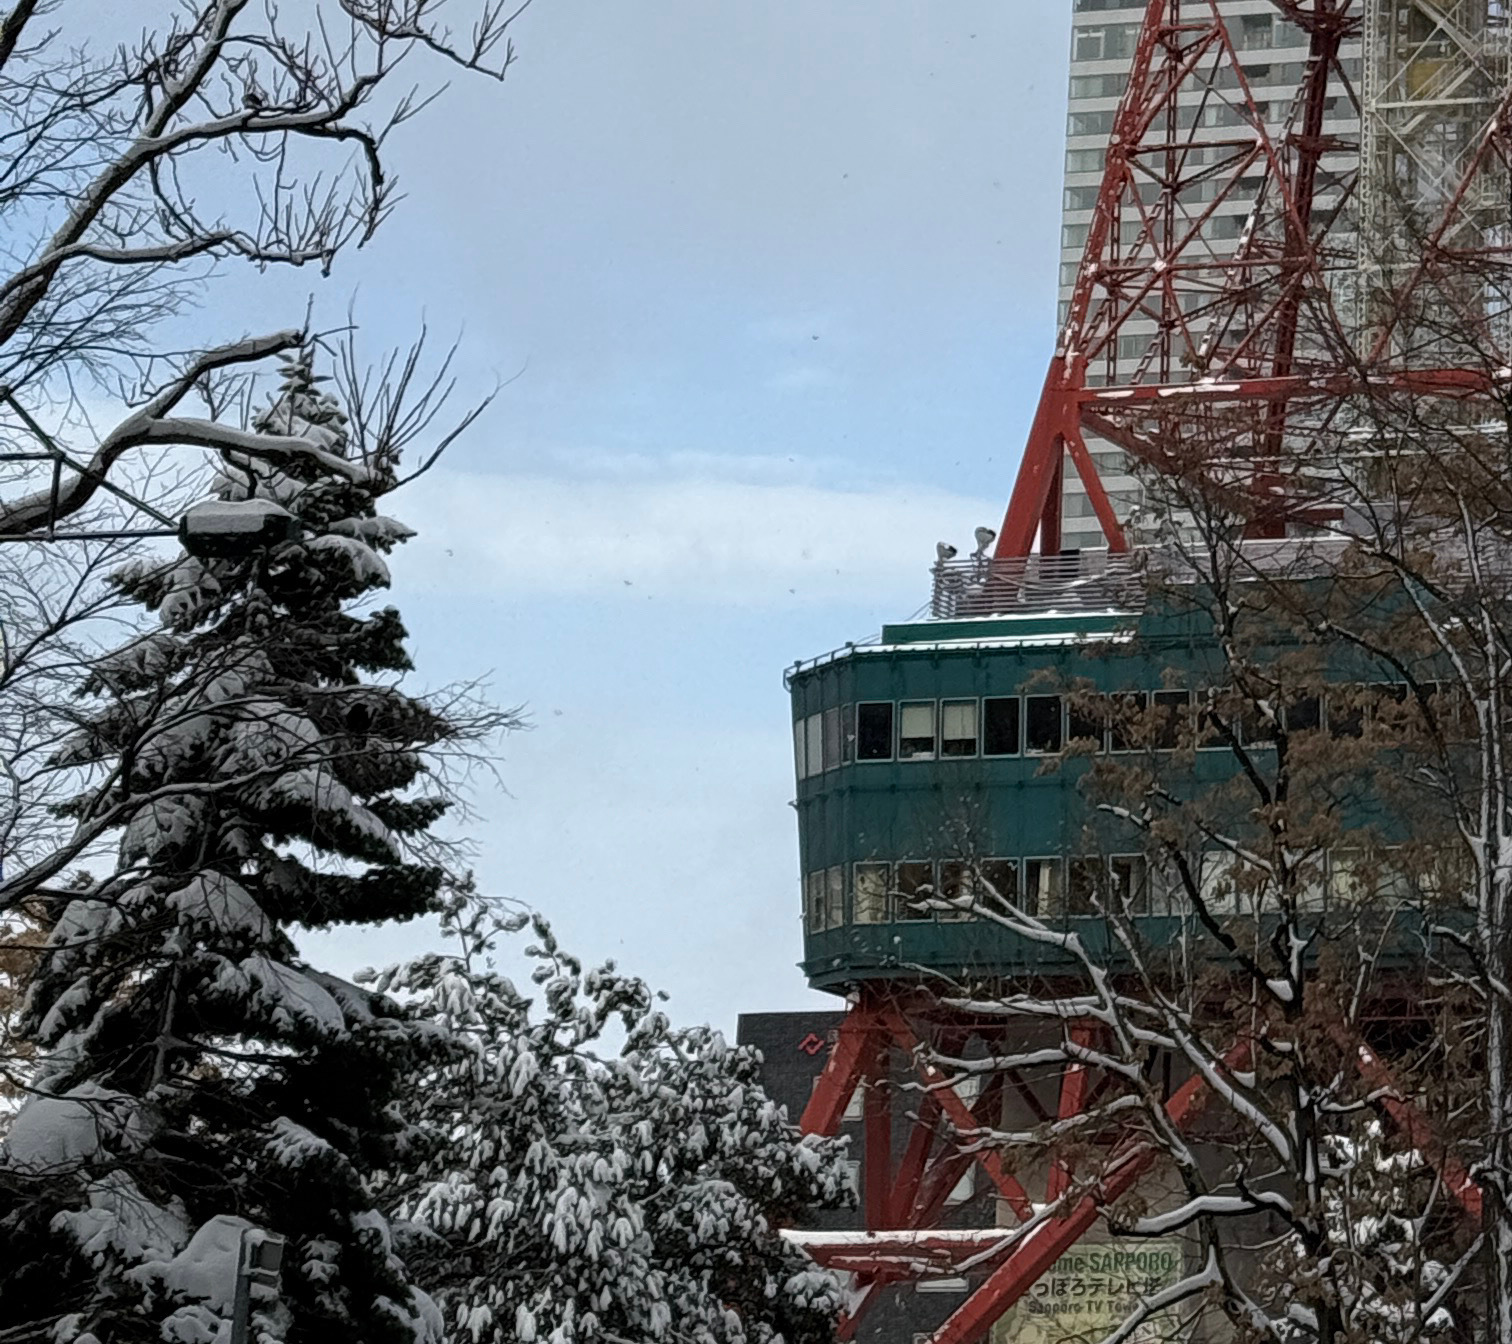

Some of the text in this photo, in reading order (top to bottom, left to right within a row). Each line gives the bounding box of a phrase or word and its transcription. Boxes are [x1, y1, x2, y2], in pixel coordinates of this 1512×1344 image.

[1089, 1251, 1172, 1273] SAPPORO
[1028, 1300, 1081, 1316] Sapporo
[1086, 1299, 1103, 1312] TV
